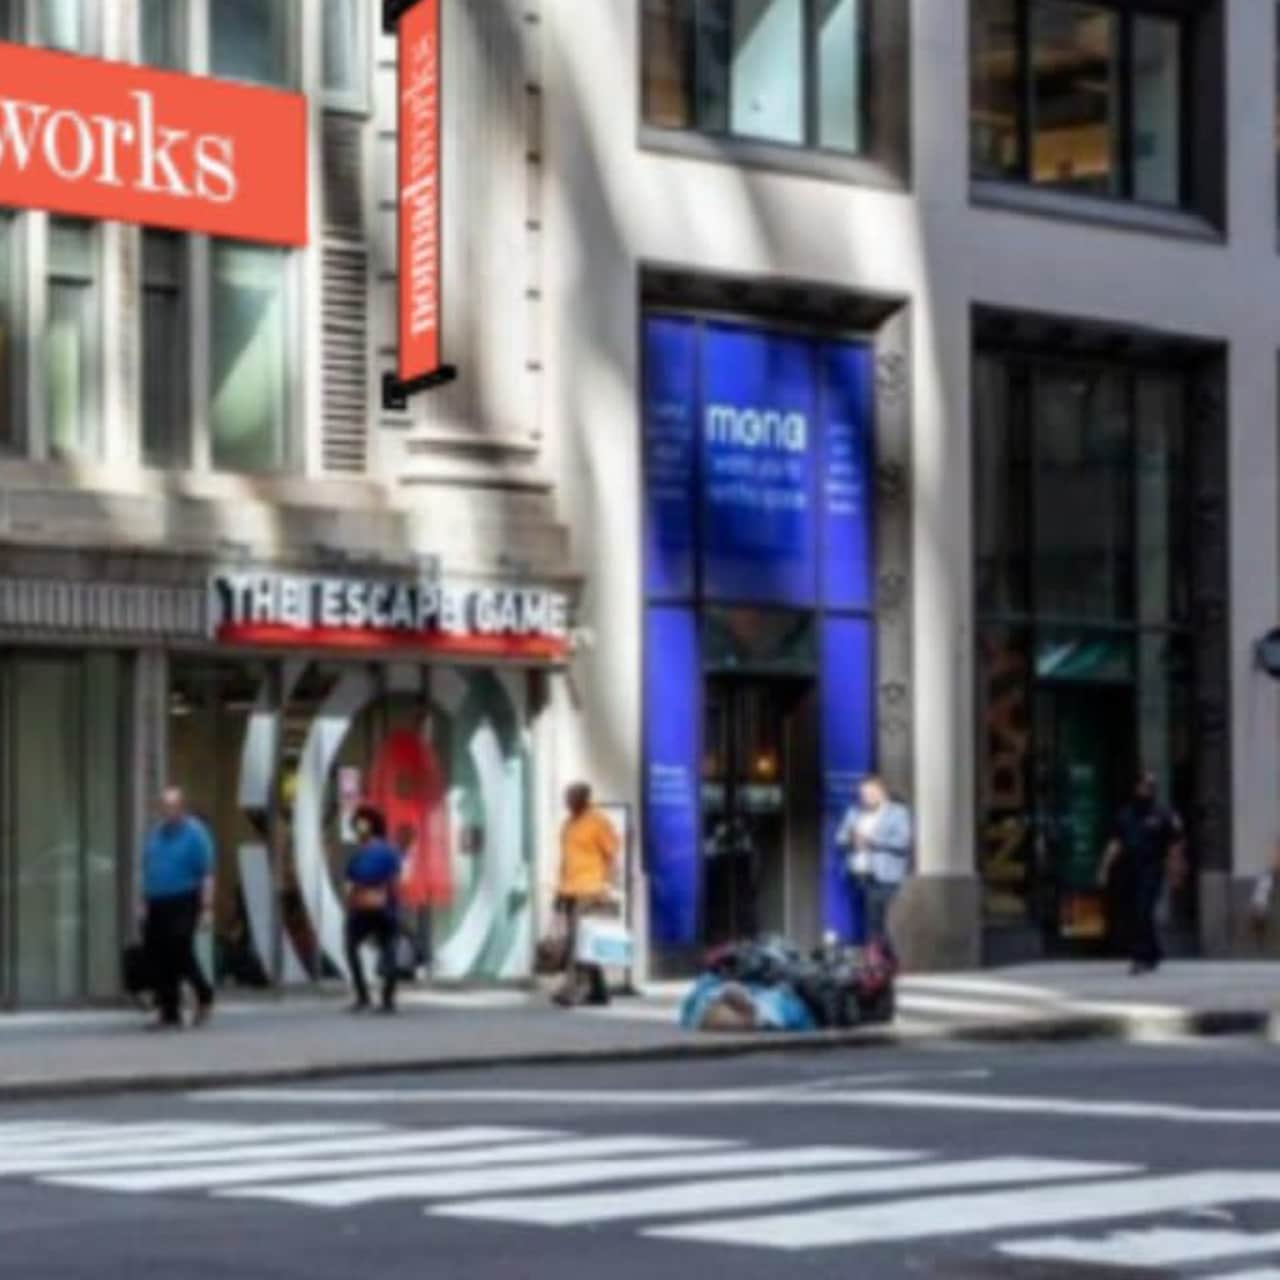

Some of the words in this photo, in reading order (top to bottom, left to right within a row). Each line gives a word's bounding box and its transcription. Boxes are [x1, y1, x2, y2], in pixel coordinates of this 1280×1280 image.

[402, 34, 437, 336] nomadworks
[230, 574, 304, 627] THE
[325, 579, 462, 635] ESCAPE
[474, 588, 571, 638] GAME
